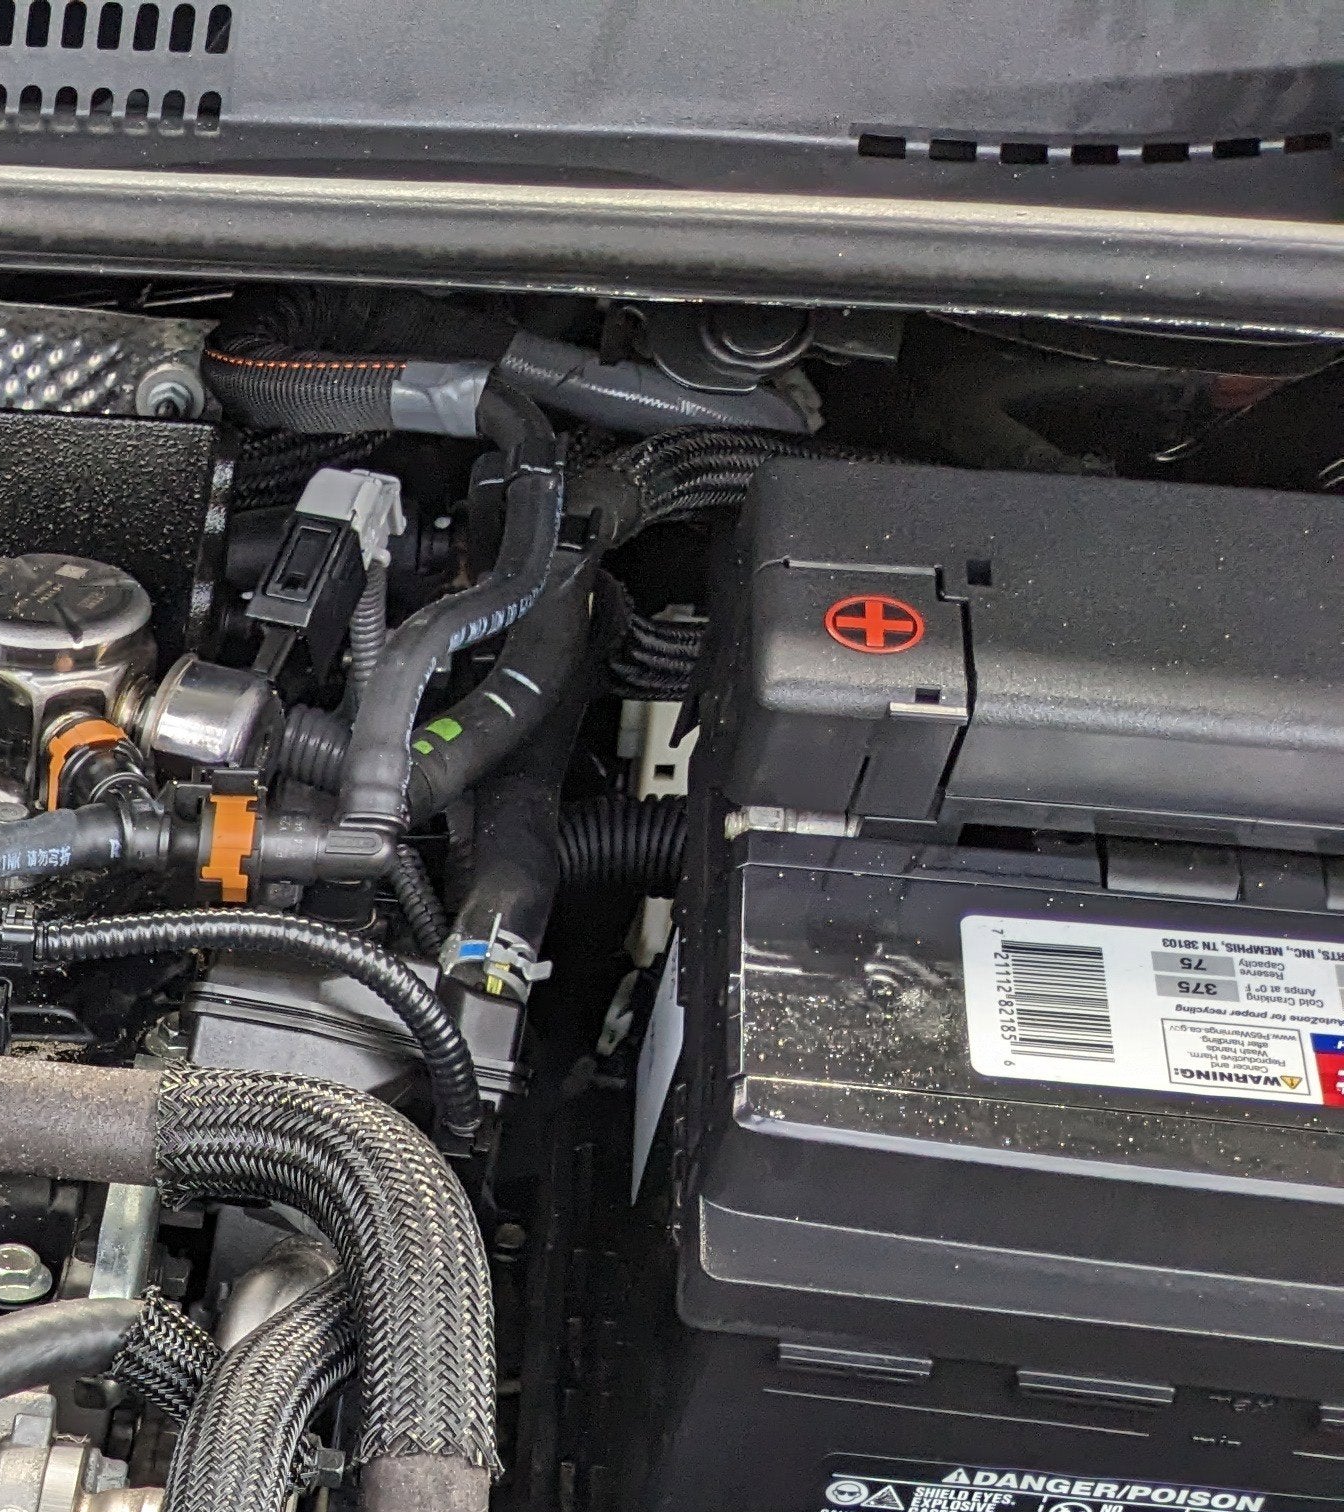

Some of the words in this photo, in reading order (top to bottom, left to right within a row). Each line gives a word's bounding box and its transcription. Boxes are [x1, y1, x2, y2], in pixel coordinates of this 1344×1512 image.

[1161, 938, 1199, 947] 38103
[1202, 940, 1218, 951] TN
[1221, 942, 1284, 956] MEMPHIS,
[1180, 958, 1207, 971] 75
[1239, 958, 1285, 971] Capacity
[1240, 969, 1284, 980] Reserve
[1177, 981, 1217, 996] 375
[1284, 987, 1316, 996] Amps
[1246, 993, 1295, 1006] Cranking
[1299, 999, 1324, 1008] Cold
[1175, 1004, 1227, 1016] recycling
[1229, 1010, 1268, 1020] proper
[1271, 1013, 1286, 1021] for
[1207, 1044, 1239, 1054] hands
[1245, 1040, 1268, 1048] after
[1240, 1047, 1268, 1057] Wash
[1211, 1061, 1230, 1069] and
[1227, 1054, 1285, 1067] Reproductive
[1233, 1063, 1268, 1073] Cancer
[1174, 1068, 1281, 1087] WARNING:
[914, 1486, 969, 1501] SHIELD
[971, 1492, 1016, 1506] EYES.
[971, 1471, 1266, 1512] DANGER/POISON
[911, 1499, 995, 1512] EXPLOSIVE
